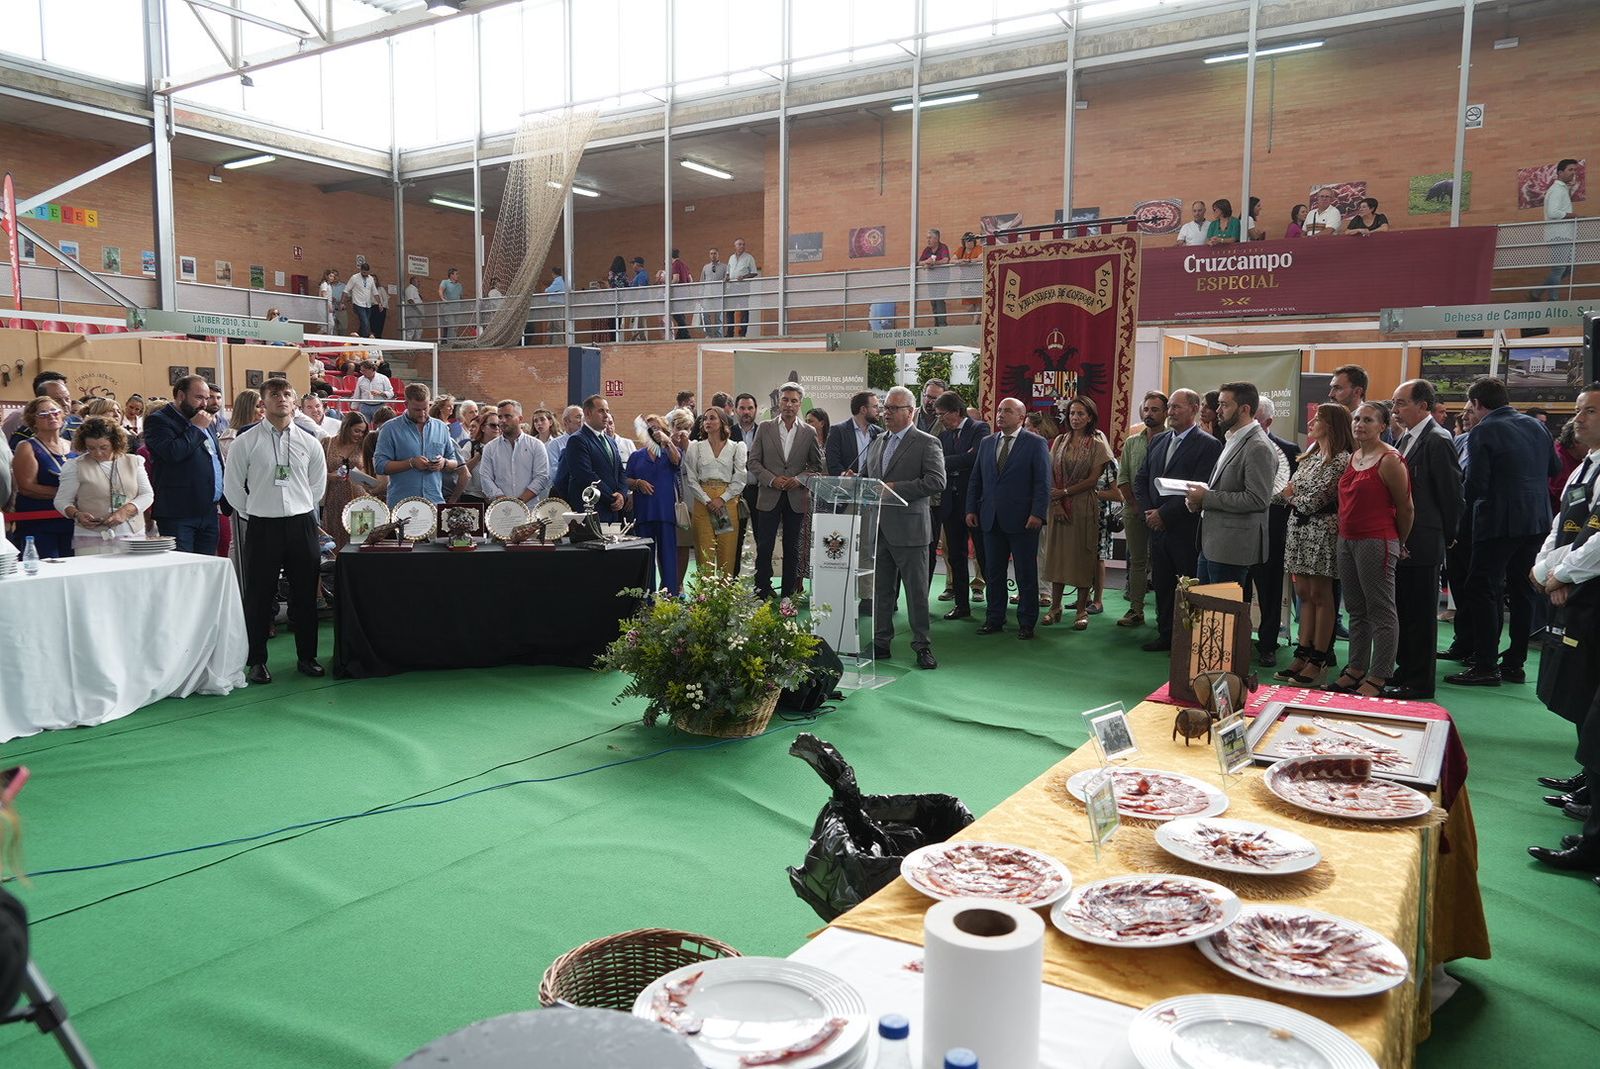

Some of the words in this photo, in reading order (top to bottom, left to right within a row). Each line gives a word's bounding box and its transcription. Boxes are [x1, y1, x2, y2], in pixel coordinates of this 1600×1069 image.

[1183, 252, 1293, 273] Cruzcampo
[1196, 273, 1280, 291] ESPECIAL
[1096, 269, 1111, 309] 2004
[193, 315, 221, 325] LATIBER
[1444, 311, 1482, 323] Dehesa
[1487, 311, 1500, 321] de
[1503, 309, 1542, 321] Campo
[227, 328, 236, 336] La
[894, 330, 902, 338] de
[842, 374, 864, 384] JAMÓN
[1271, 388, 1292, 399] JAMÓN
